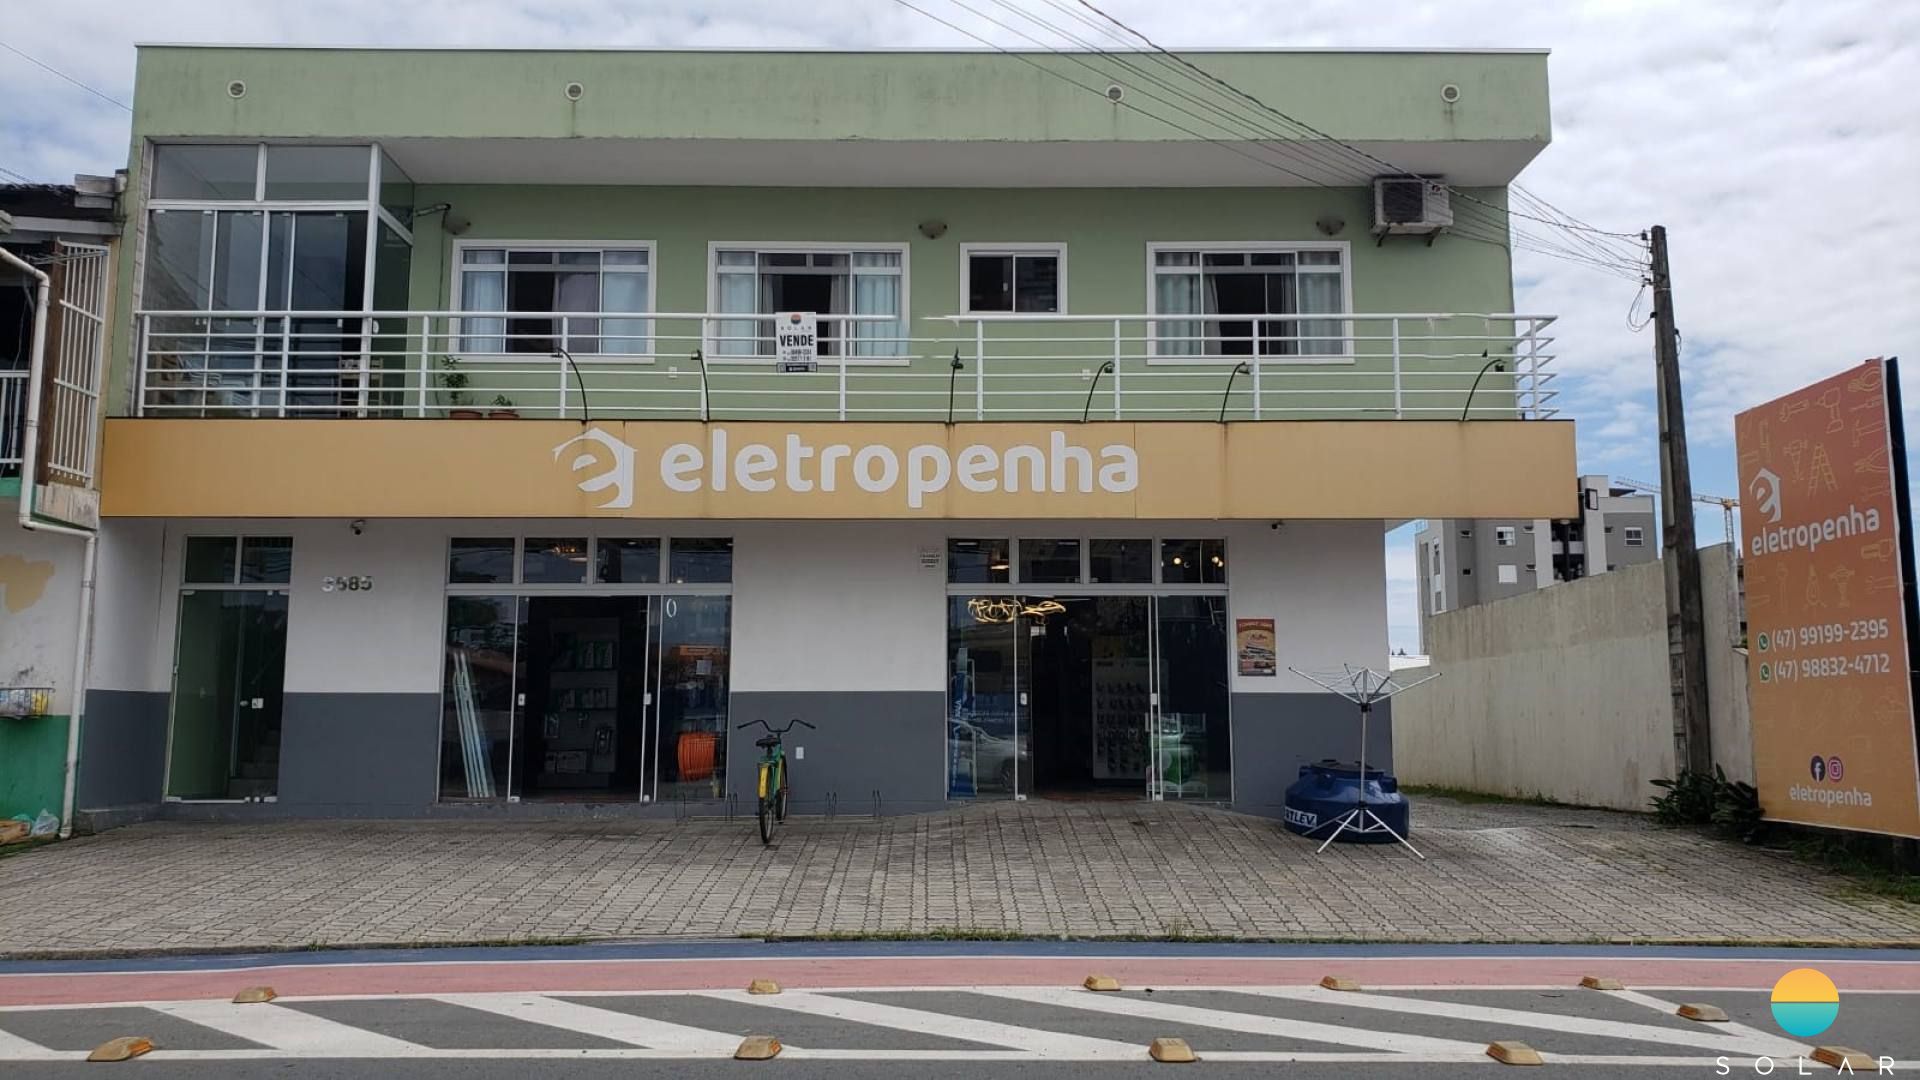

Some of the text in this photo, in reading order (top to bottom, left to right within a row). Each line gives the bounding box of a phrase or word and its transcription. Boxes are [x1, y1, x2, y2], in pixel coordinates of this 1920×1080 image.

[780, 334, 814, 347] VENDE
[660, 428, 1138, 508] eletropenha
[1752, 504, 1879, 556] eletropenha
[1772, 618, 1889, 652] (47) 99199-2395
[1774, 653, 1890, 684] (47) 98832-4712
[1789, 784, 1872, 808] eletropenha
